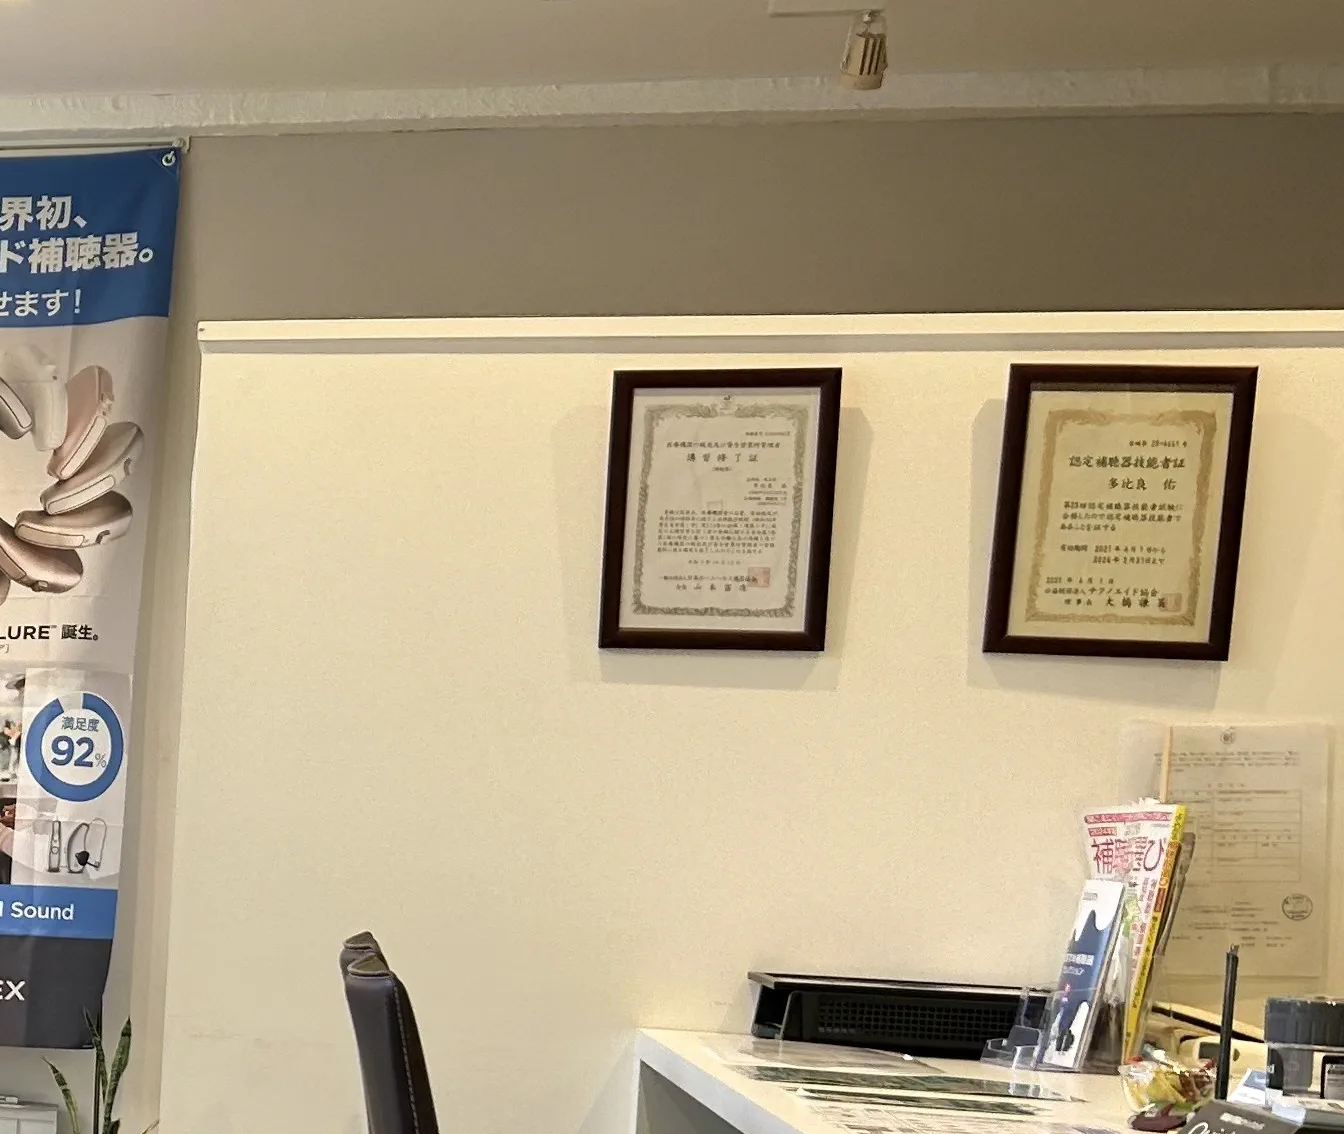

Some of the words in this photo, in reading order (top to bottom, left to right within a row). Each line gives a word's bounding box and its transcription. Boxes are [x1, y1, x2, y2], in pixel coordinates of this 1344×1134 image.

[61, 624, 98, 641] 誕生。
[62, 716, 100, 733] 満足度
[11, 901, 75, 920] Sound
